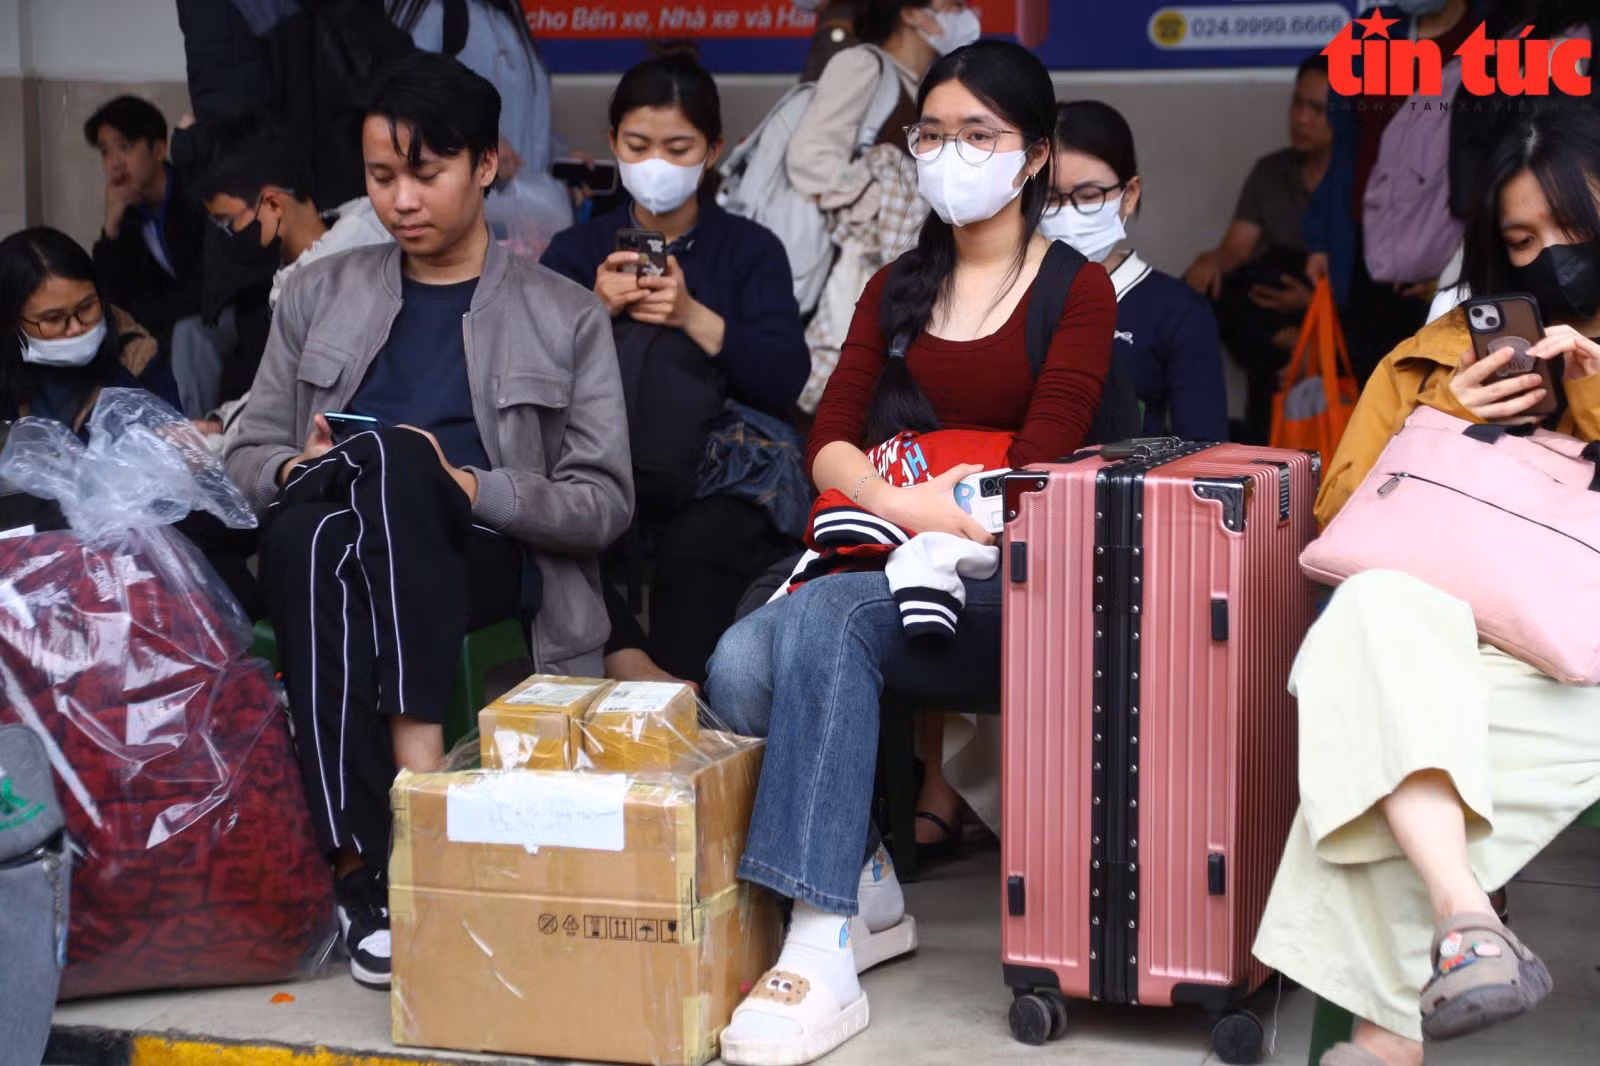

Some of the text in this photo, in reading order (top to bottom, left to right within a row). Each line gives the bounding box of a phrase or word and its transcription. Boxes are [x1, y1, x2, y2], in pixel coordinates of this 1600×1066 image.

[525, 7, 567, 31] cho
[712, 9, 739, 31] xe
[744, 4, 771, 30] và
